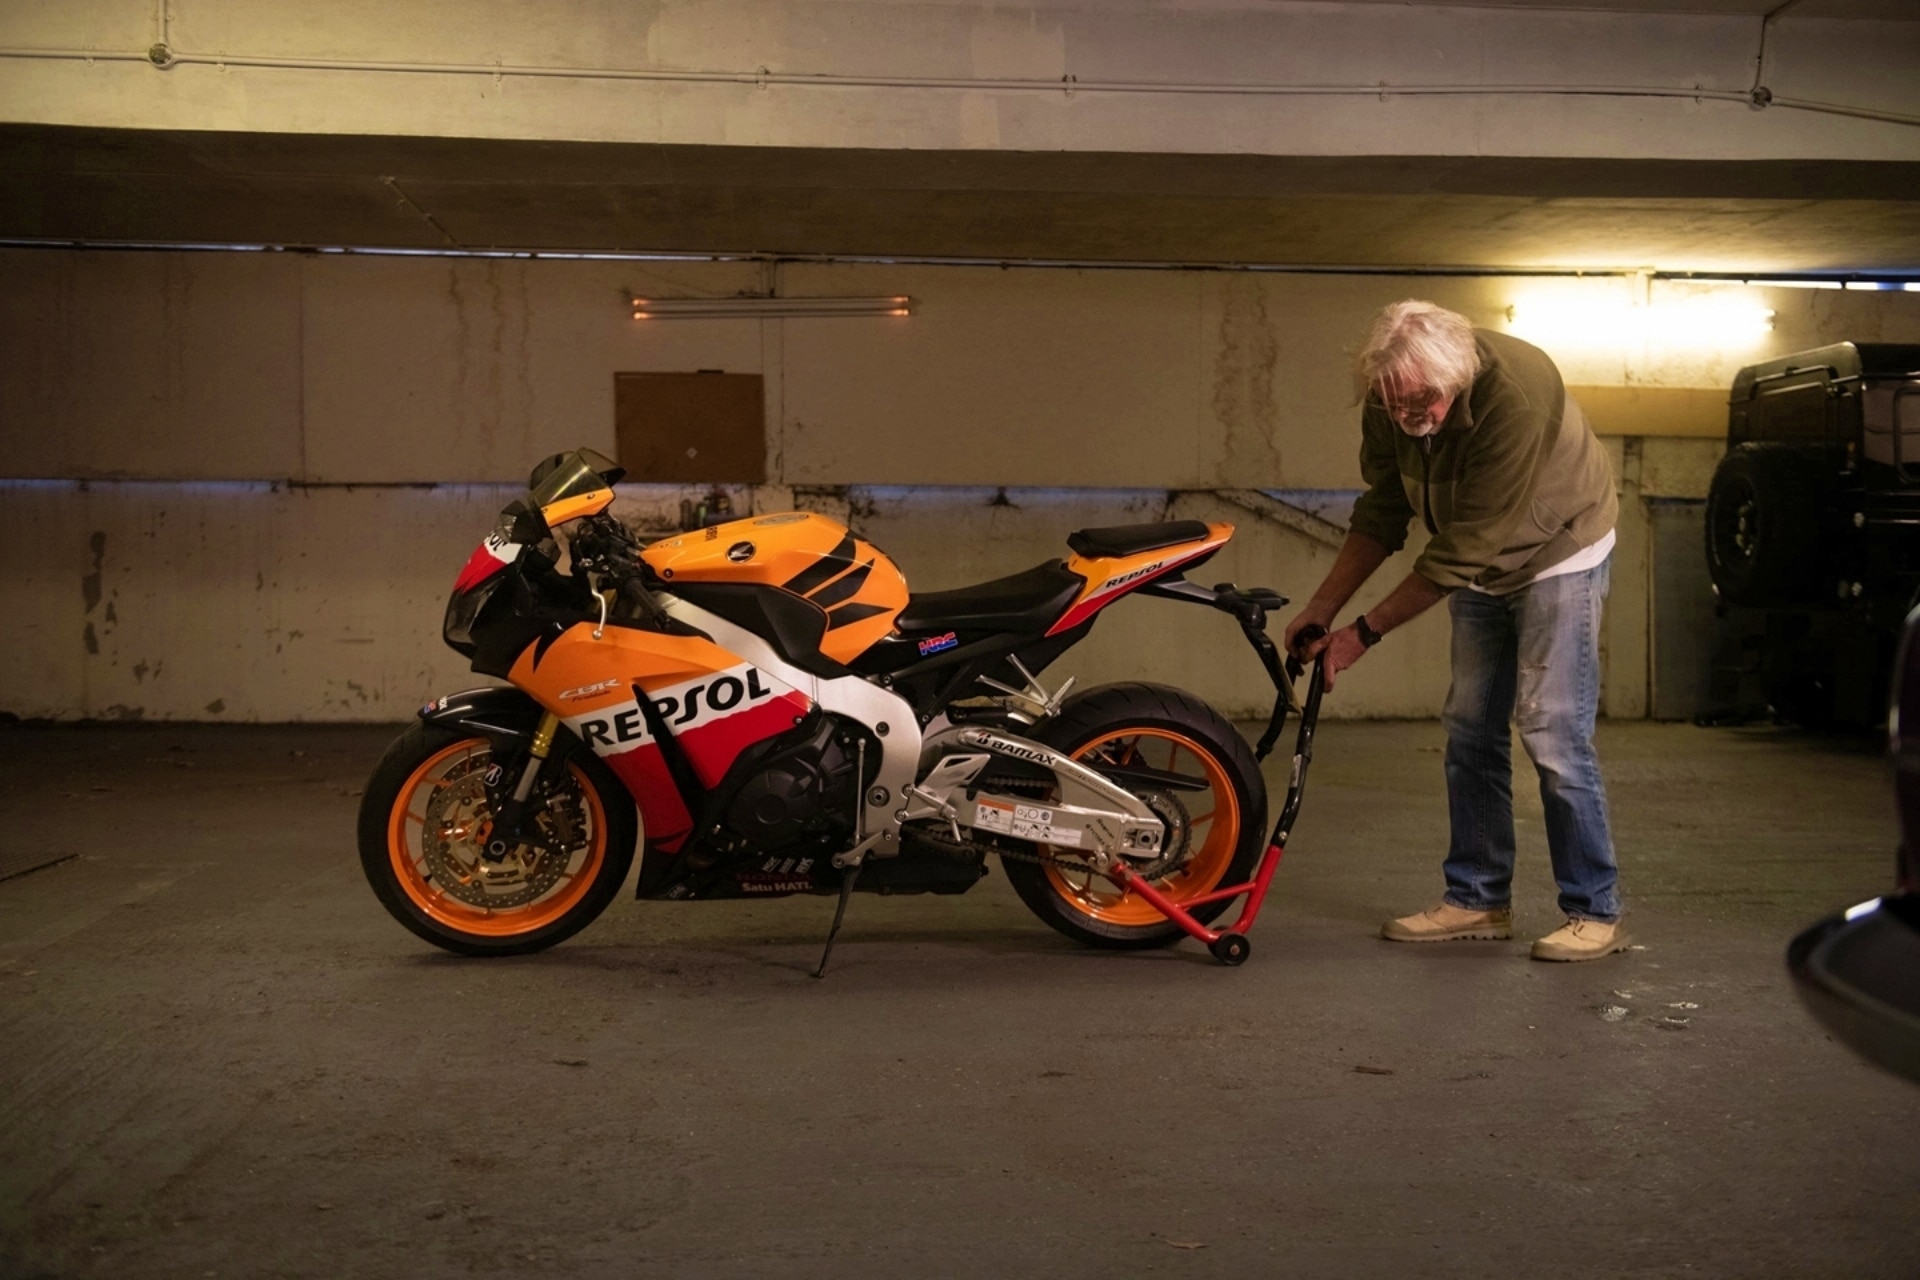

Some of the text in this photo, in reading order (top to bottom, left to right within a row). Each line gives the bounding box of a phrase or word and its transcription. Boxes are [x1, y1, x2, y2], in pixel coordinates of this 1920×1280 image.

[1105, 561, 1166, 589] REPSOL
[918, 632, 957, 656] HRC
[559, 678, 622, 700] CBR
[580, 668, 770, 748] REPSOL
[742, 882, 773, 892] Satu
